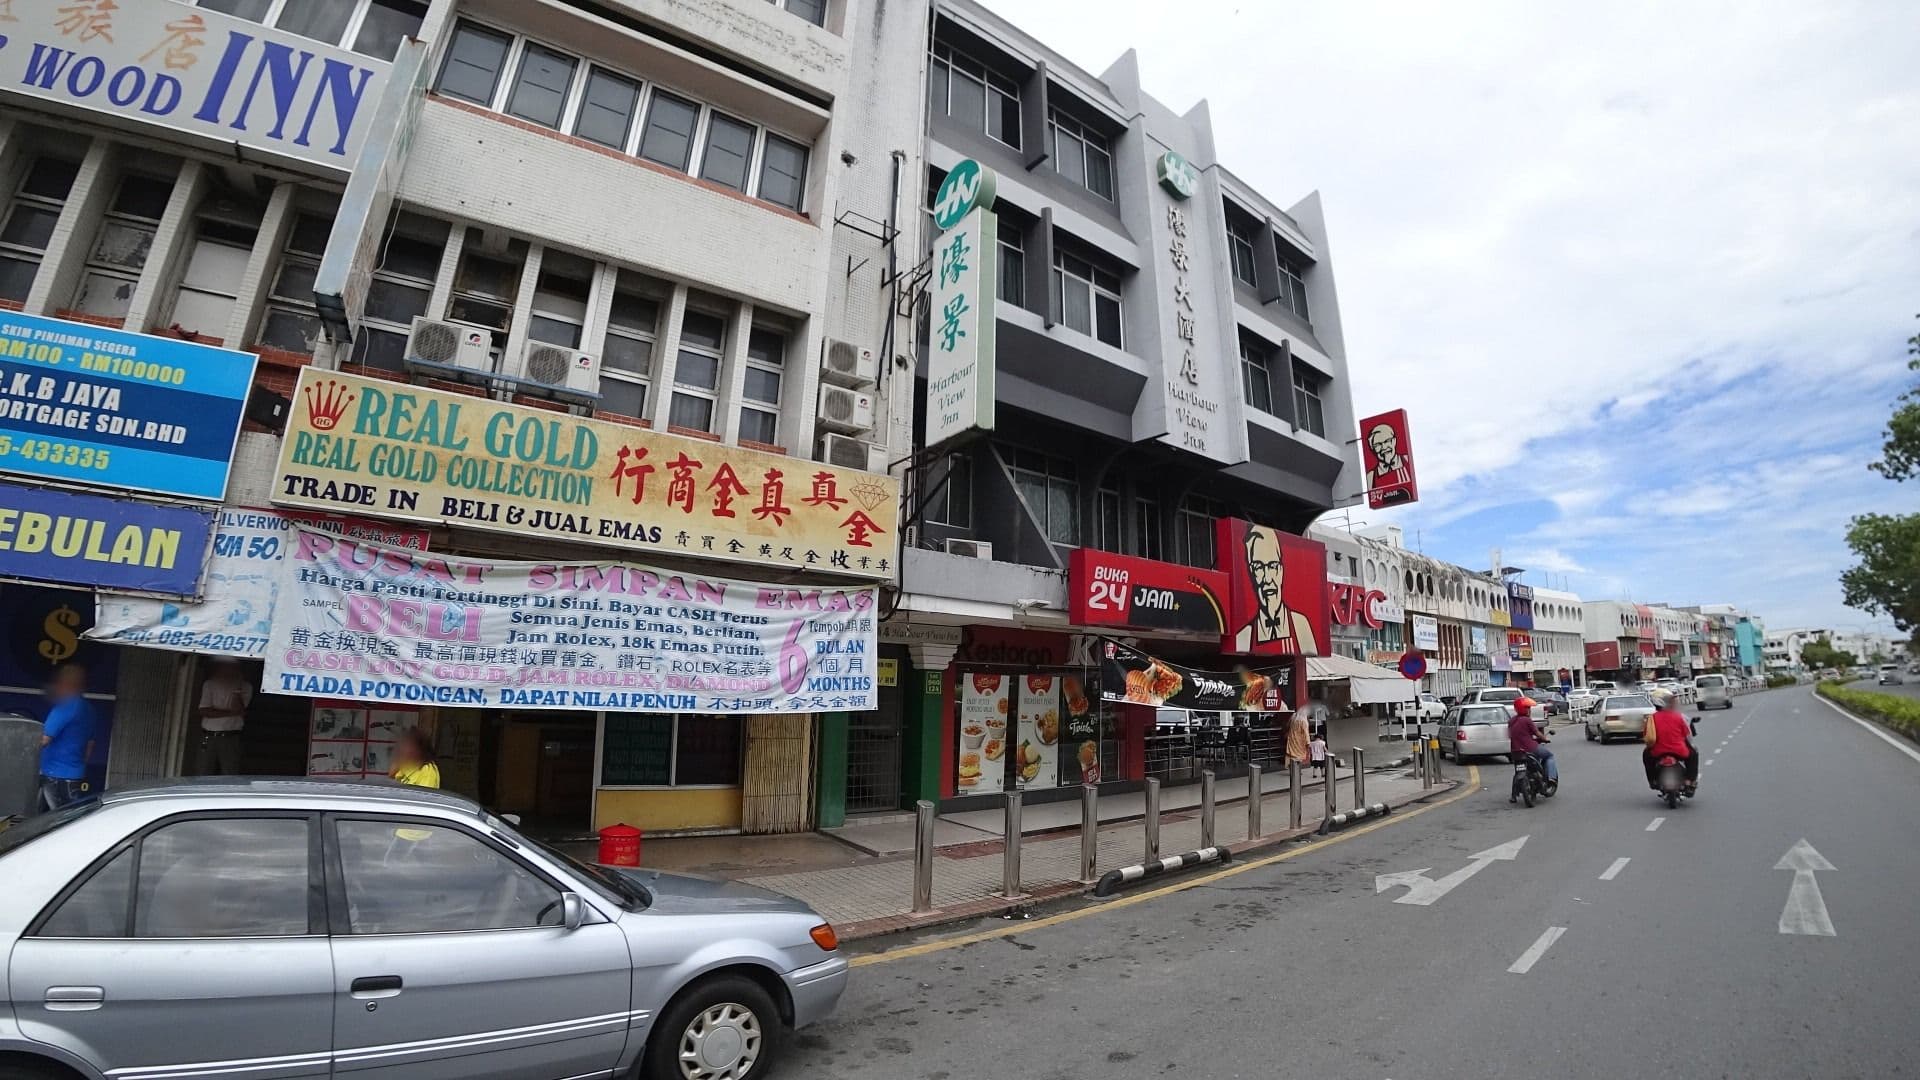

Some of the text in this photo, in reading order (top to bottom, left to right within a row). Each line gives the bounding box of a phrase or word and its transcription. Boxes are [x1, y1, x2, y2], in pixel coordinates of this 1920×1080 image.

[0, 0, 207, 70] 旅店
[21, 43, 182, 116] WOOD
[193, 31, 374, 155] INN
[937, 232, 970, 352] 濠景
[1, 324, 137, 357] SKIM PINJAMAN SEGERA
[0, 337, 62, 365] RM100
[80, 352, 187, 385] RM100000
[930, 359, 975, 393] Harbour
[61, 381, 121, 411] JAYA
[938, 386, 966, 411] View
[1168, 381, 1218, 413] Harbour
[95, 413, 187, 445] SDN.BHD
[352, 386, 598, 472] REAL GOLD
[940, 411, 960, 430] Inn
[1175, 407, 1208, 430] View
[1184, 431, 1207, 451] Inn
[291, 431, 594, 506] REAL GOLD COLLECTION
[283, 474, 662, 543] TRADE IN BELI & JUAL EMAS
[0, 508, 181, 569] EBULAN
[293, 529, 875, 613] PUSAT SIMPAN EMAS
[1094, 566, 1129, 583] BUKA
[300, 569, 768, 626] Harga Pasti Tertinggi Di Sini. Bayar CASH Terus
[303, 598, 345, 611] SAMPEL
[1088, 581, 1174, 610] 24 JAM
[1327, 581, 1387, 629] KFC
[345, 592, 486, 643] BELI
[511, 611, 760, 641] Semua Jenis Emas, Berlian,
[158, 630, 270, 652] 085-420577
[506, 629, 765, 657] Jam Rolex, 18k Emas Putih.
[779, 617, 809, 694] 6
[815, 639, 864, 654] BULAN
[285, 648, 773, 692] CASH BUY GOLD, JAM ROLEX, DIAMOND
[817, 658, 862, 673] 個月
[281, 673, 697, 709] TIADA POTONGAN, DAPAT NILAI PENUH
[807, 677, 871, 692] MONTHS
